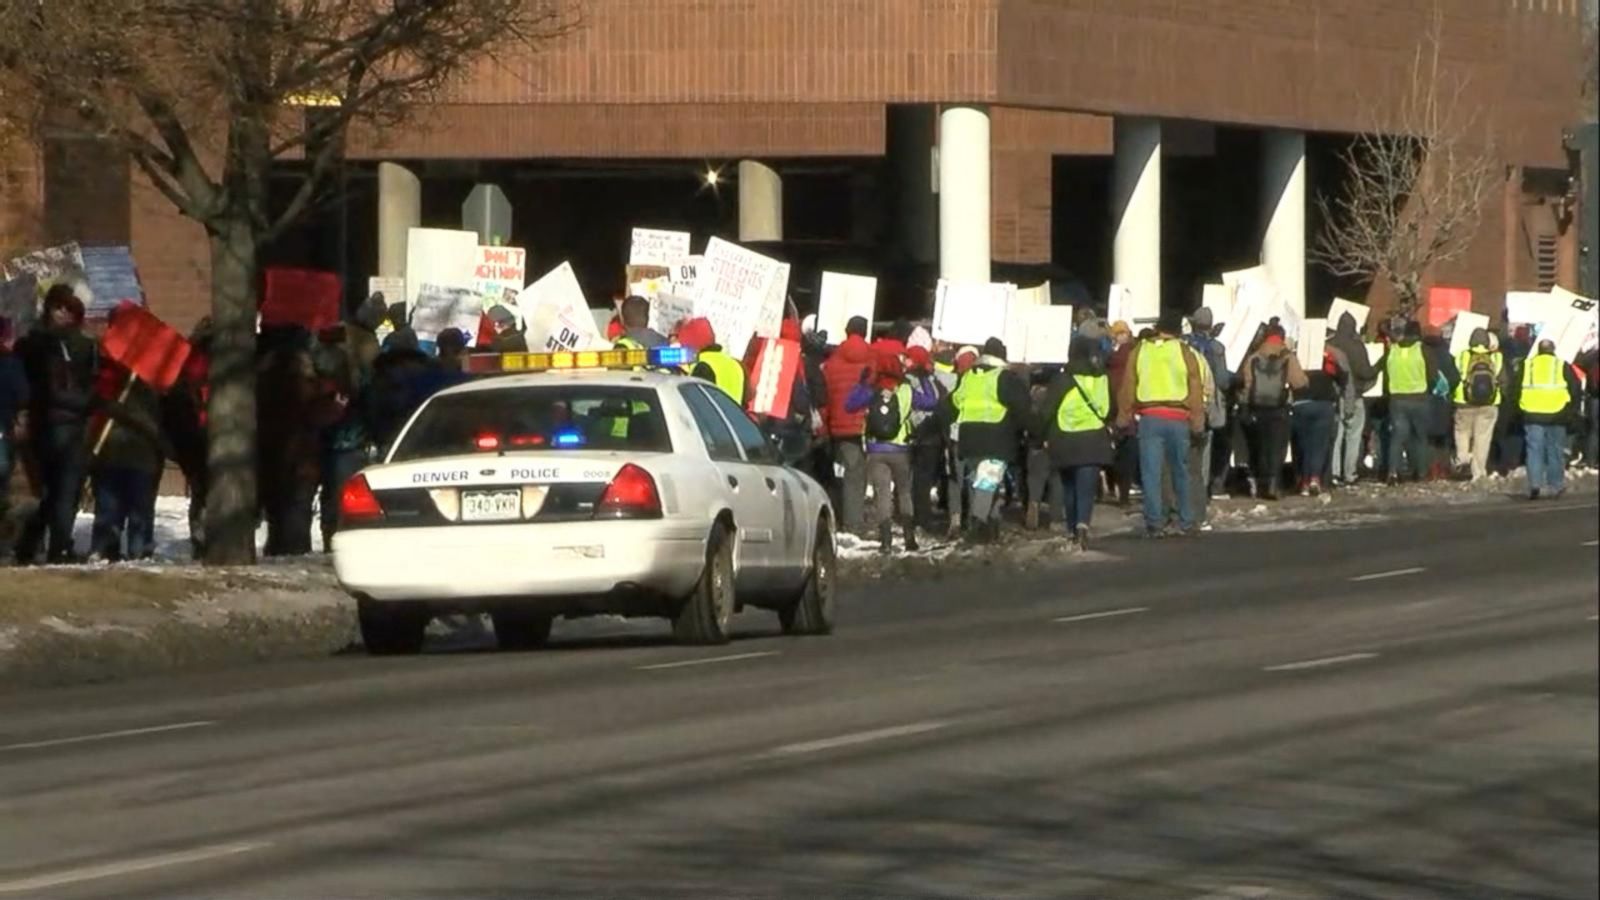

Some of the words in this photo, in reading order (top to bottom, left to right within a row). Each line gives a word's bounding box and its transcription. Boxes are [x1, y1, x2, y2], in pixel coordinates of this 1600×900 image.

[680, 265, 697, 280] ON
[559, 327, 579, 348] ON
[412, 470, 469, 483] DENVER
[510, 468, 560, 479] POLICE
